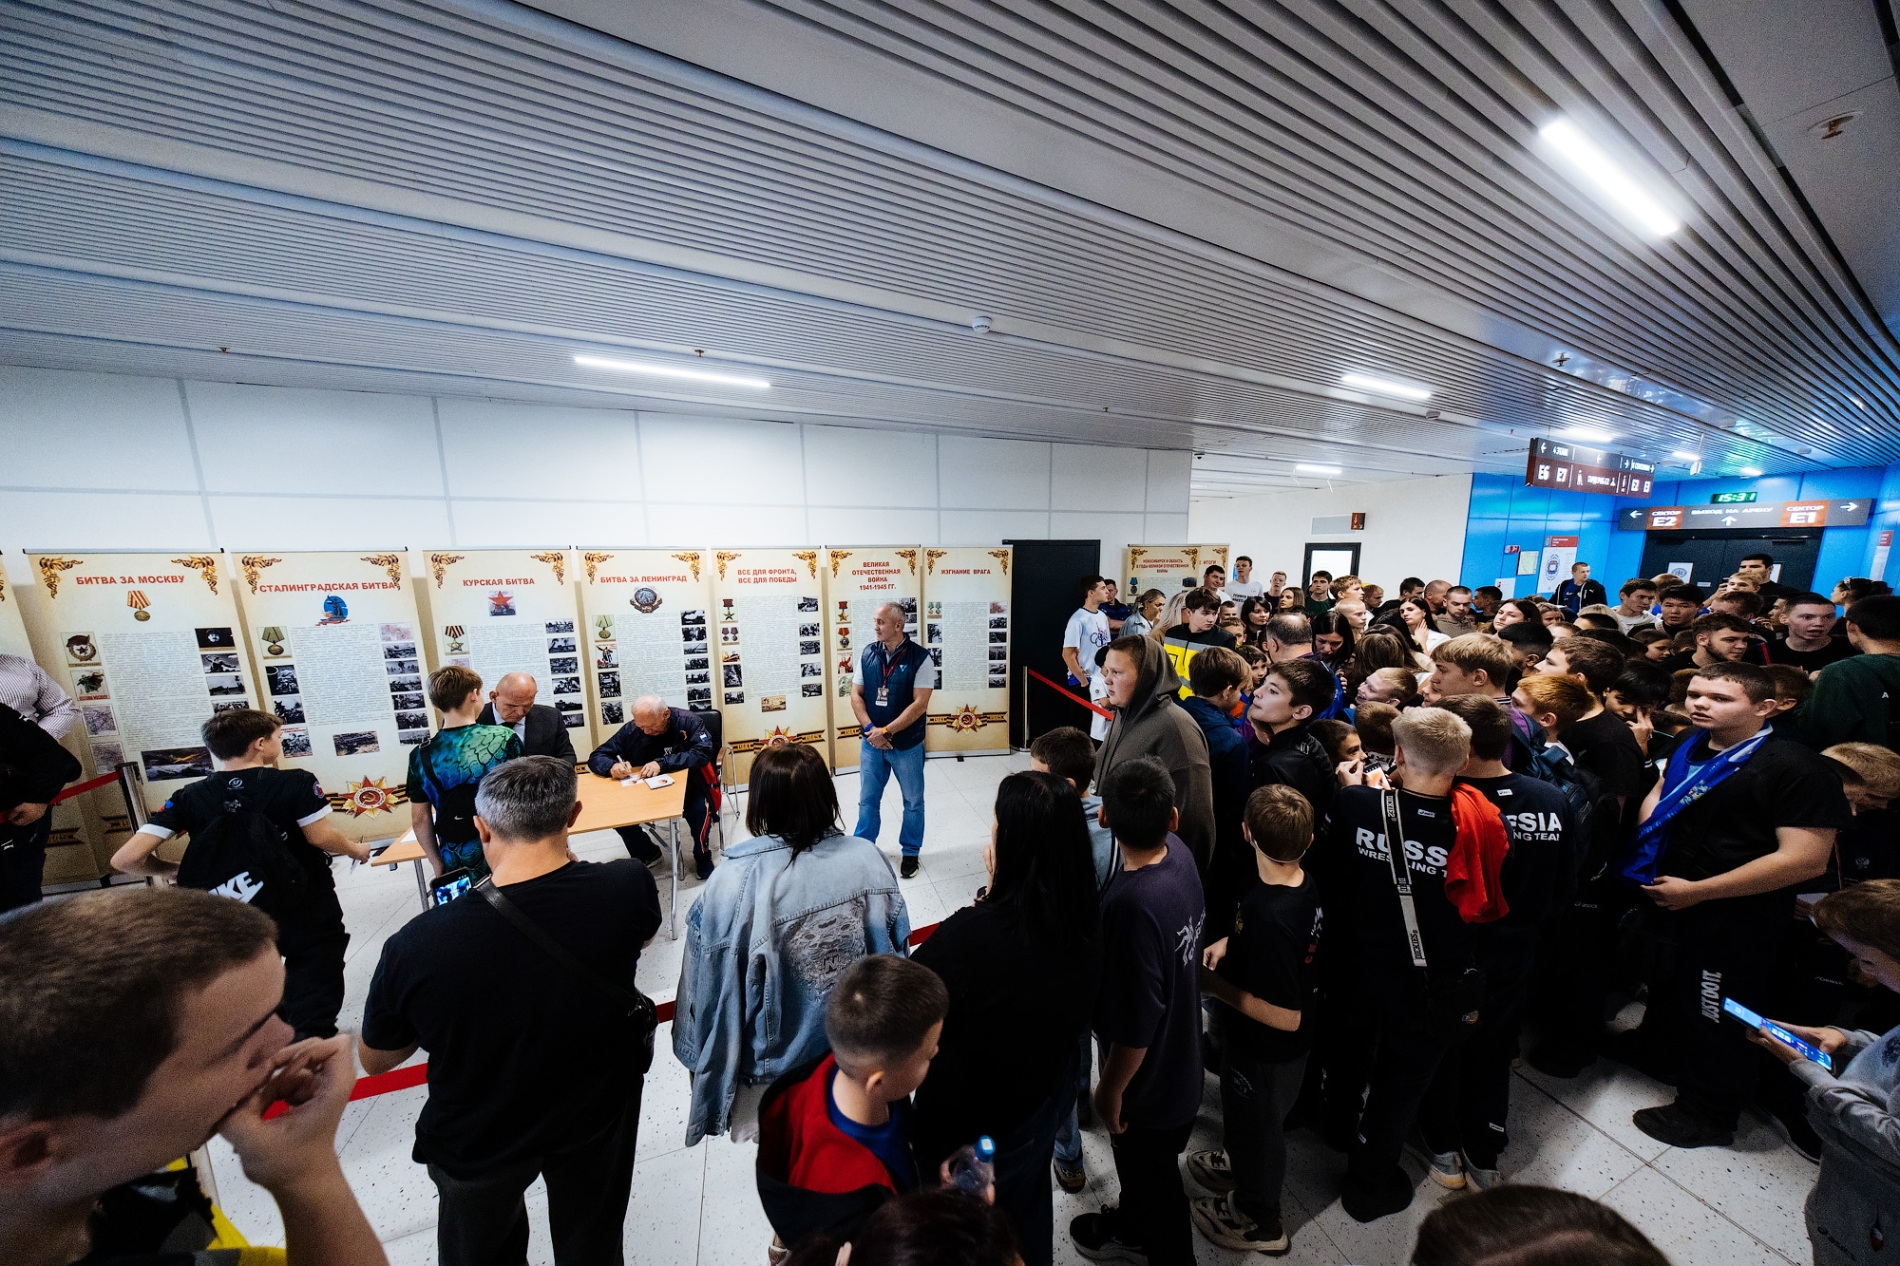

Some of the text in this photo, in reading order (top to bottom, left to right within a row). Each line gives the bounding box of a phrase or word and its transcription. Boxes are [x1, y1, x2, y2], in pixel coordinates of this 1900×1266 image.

[1538, 464, 1550, 480] E6
[1718, 492, 1756, 502] 15:31
[1652, 516, 1677, 526] E2
[1789, 511, 1816, 524] E1
[76, 574, 186, 586] БИТВА ЗА МОСКВУ
[462, 578, 535, 587] КУРСКАЯ БИТВА
[642, 575, 687, 583] ЛЕНИНГРАД
[259, 582, 396, 593] СТАЛИНГРАДСКАЯ БИТВА
[1701, 982, 1720, 1000] DO
[1701, 996, 1720, 1023] JUST
